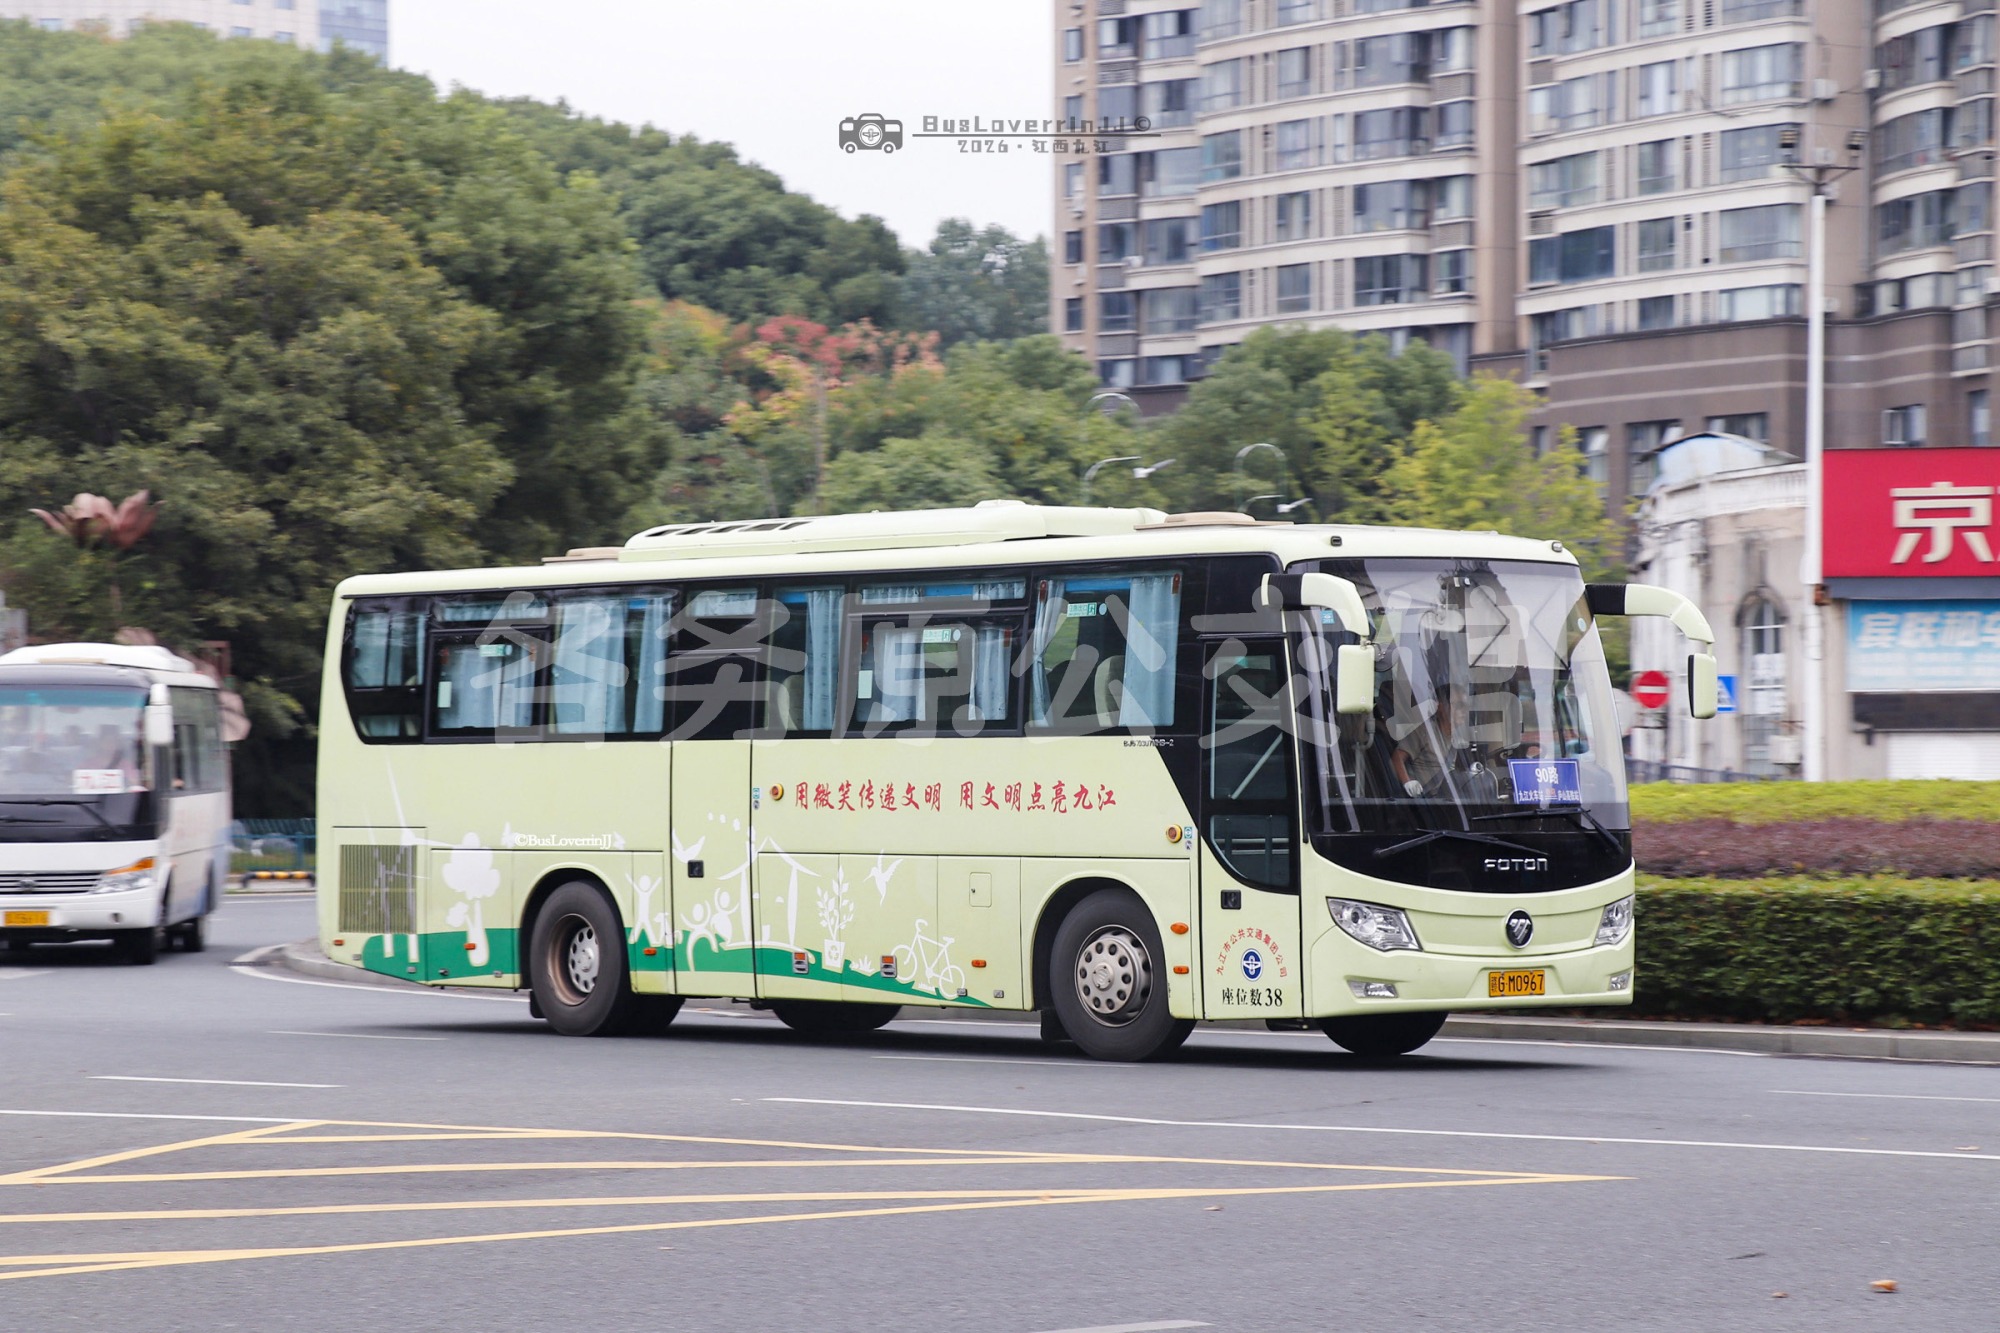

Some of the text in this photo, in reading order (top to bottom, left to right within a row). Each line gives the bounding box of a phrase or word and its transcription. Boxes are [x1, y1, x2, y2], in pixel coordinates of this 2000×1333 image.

[1889, 481, 2000, 564] 京
[1535, 766, 1559, 785] 90路
[795, 780, 1117, 814] 用微笑传递文明 用文明点亮九江
[1484, 858, 1548, 872] FOTON
[1216, 927, 1287, 978] 九江市公共交通集团公司
[1222, 987, 1283, 1007] 座位数38
